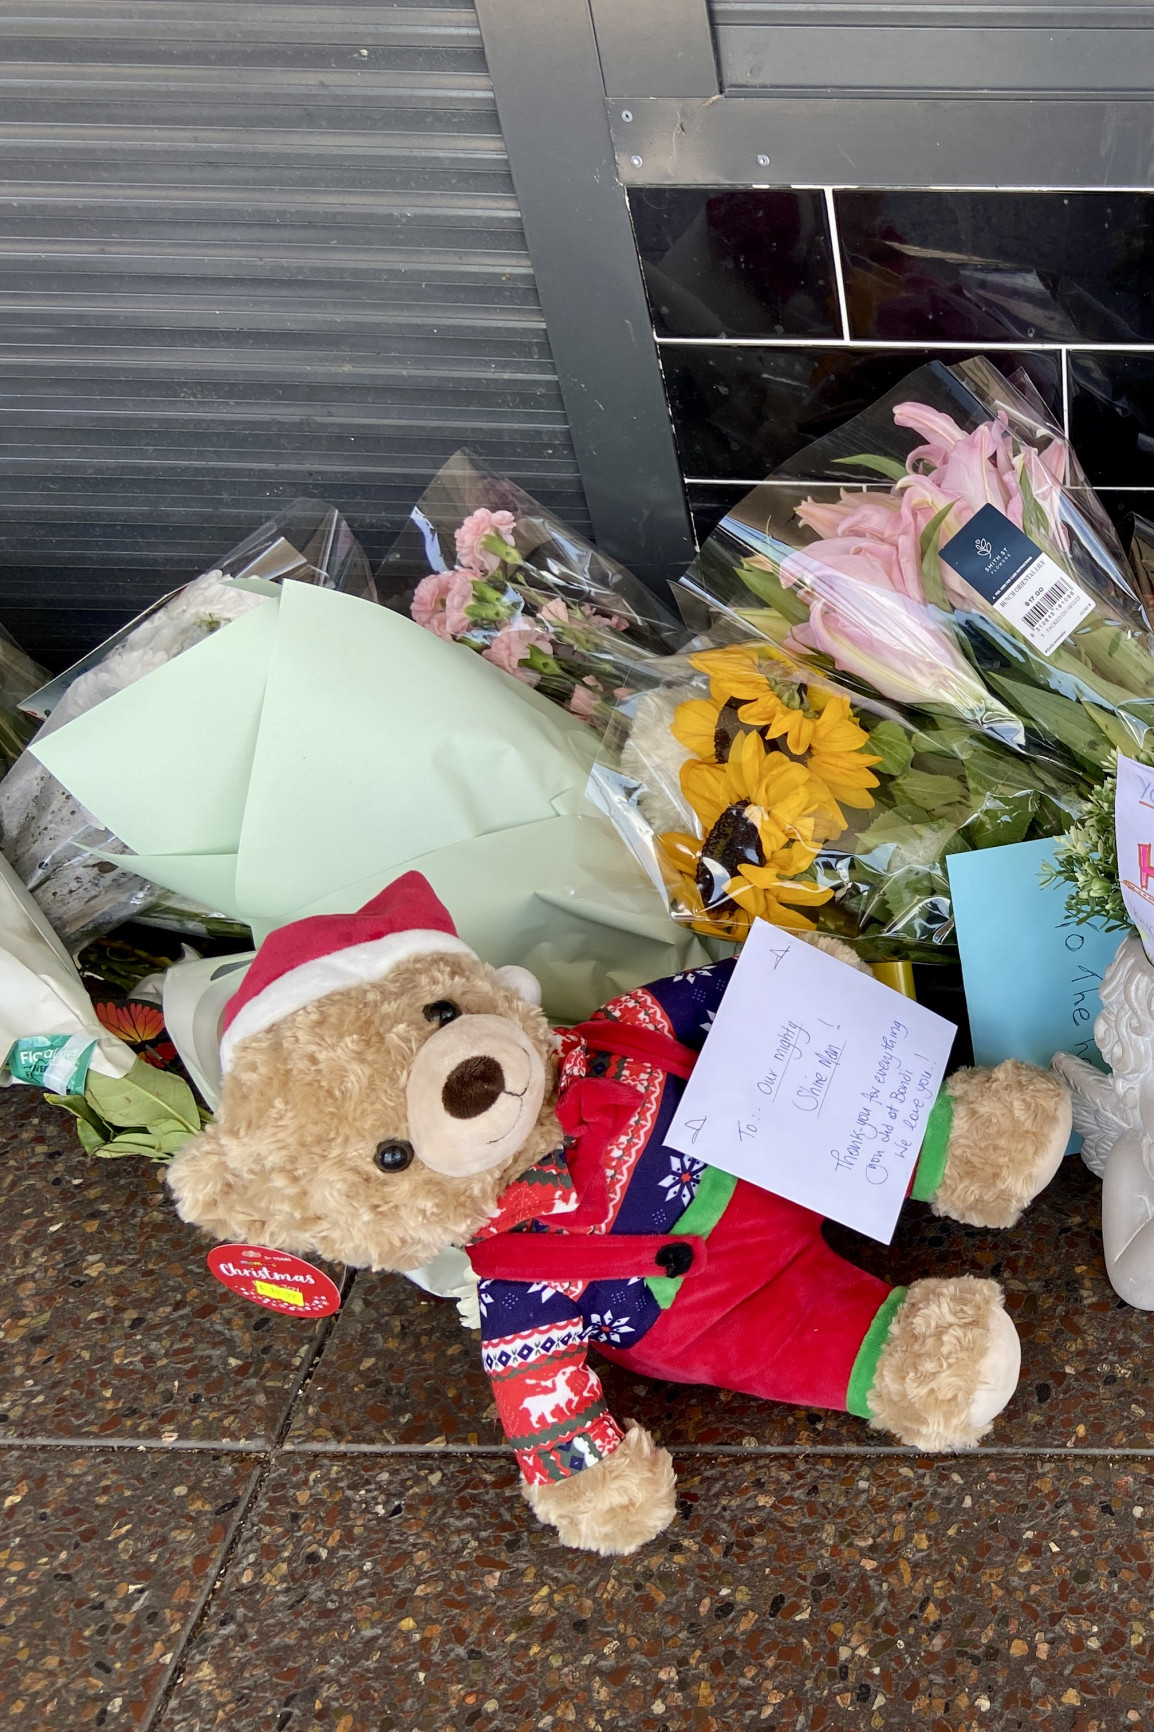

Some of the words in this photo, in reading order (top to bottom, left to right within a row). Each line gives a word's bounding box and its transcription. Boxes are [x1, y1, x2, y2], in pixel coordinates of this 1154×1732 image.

[985, 555, 1001, 572] SMITH
[1001, 547, 1008, 556] ST
[991, 554, 1011, 574] FLOWERS
[1000, 590, 1016, 607] BUNCH
[1014, 570, 1035, 592] ORIENTAL
[1034, 559, 1045, 571] LILY
[1025, 587, 1044, 606] $17.00
[1046, 616, 1062, 632] PACKED
[756, 1068, 778, 1095] Our
[773, 1020, 811, 1061] mighty
[860, 1085, 883, 1106] for
[874, 1020, 909, 1084] everything
[889, 1070, 914, 1104] Bondi
[894, 1139, 912, 1159] We
[903, 1098, 925, 1131] love
[219, 1262, 316, 1284] Christmas
